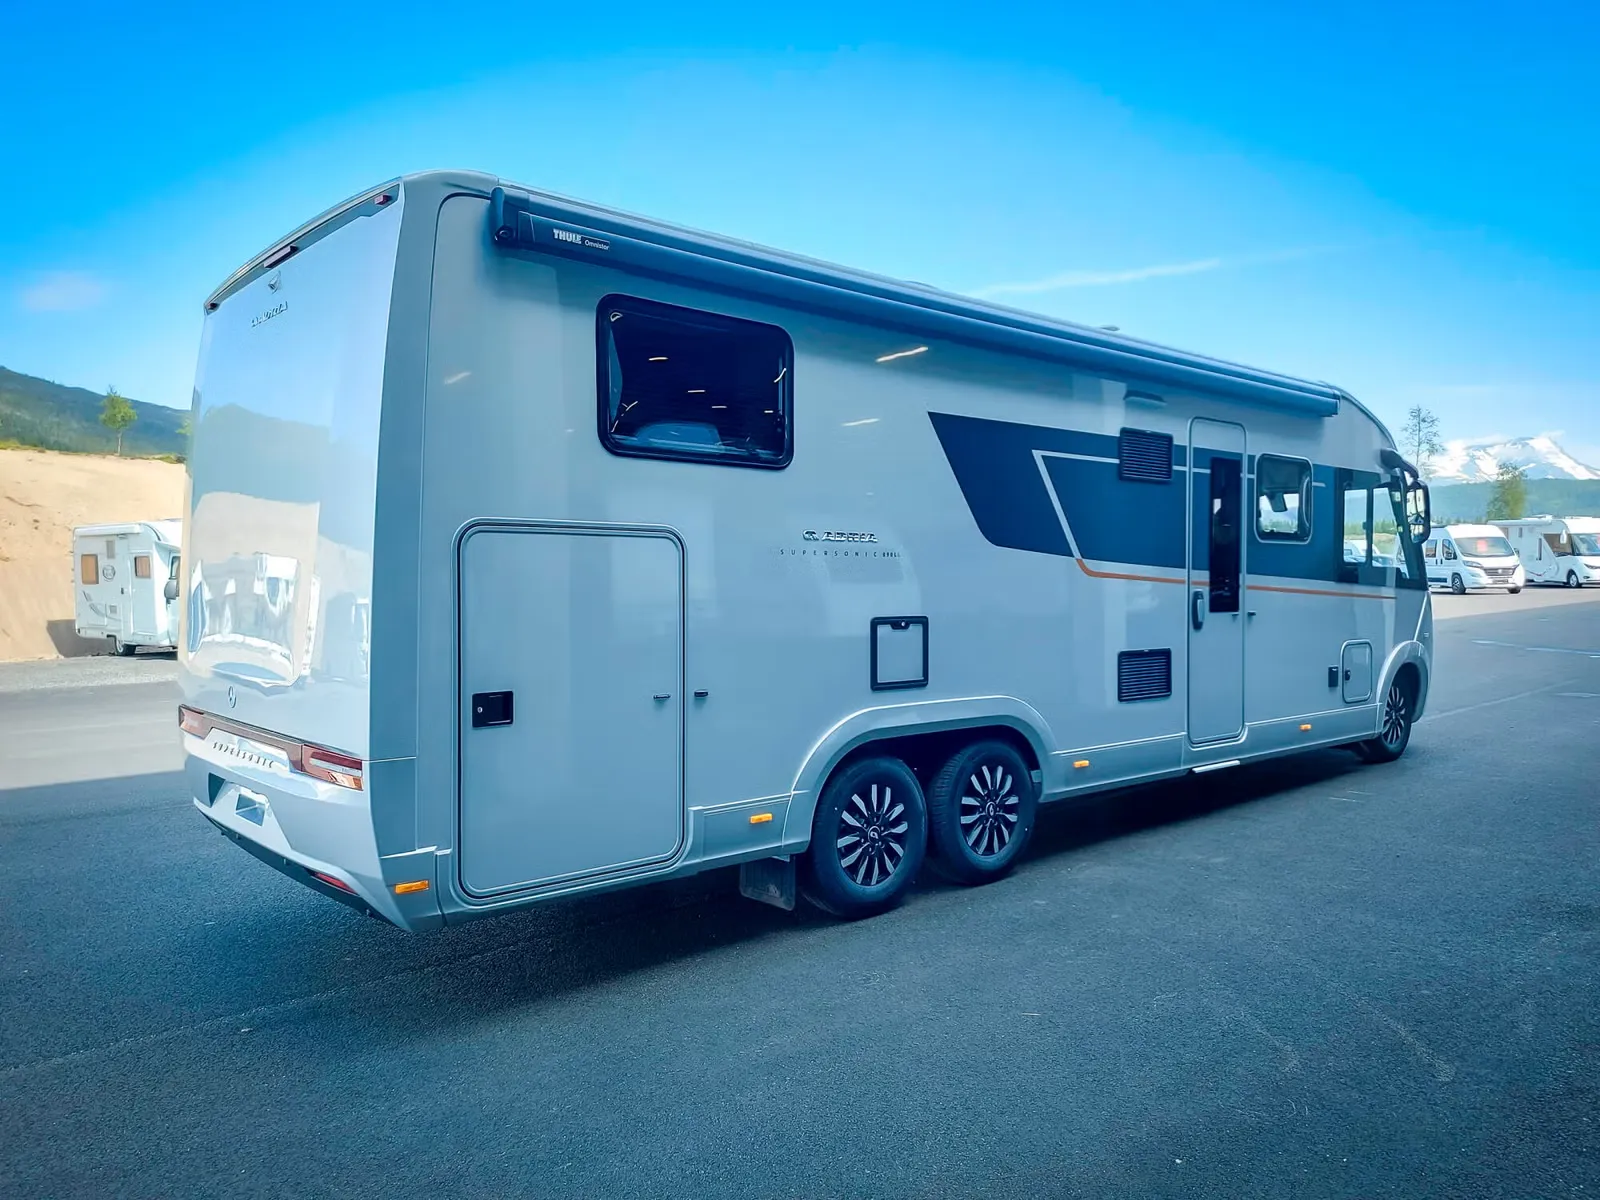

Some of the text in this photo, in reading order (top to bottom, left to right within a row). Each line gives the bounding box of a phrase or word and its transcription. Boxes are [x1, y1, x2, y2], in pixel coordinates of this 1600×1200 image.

[552, 228, 610, 251] THULE Omnistor
[821, 530, 878, 543] ADRIA
[780, 549, 877, 558] SUPERSONIC
